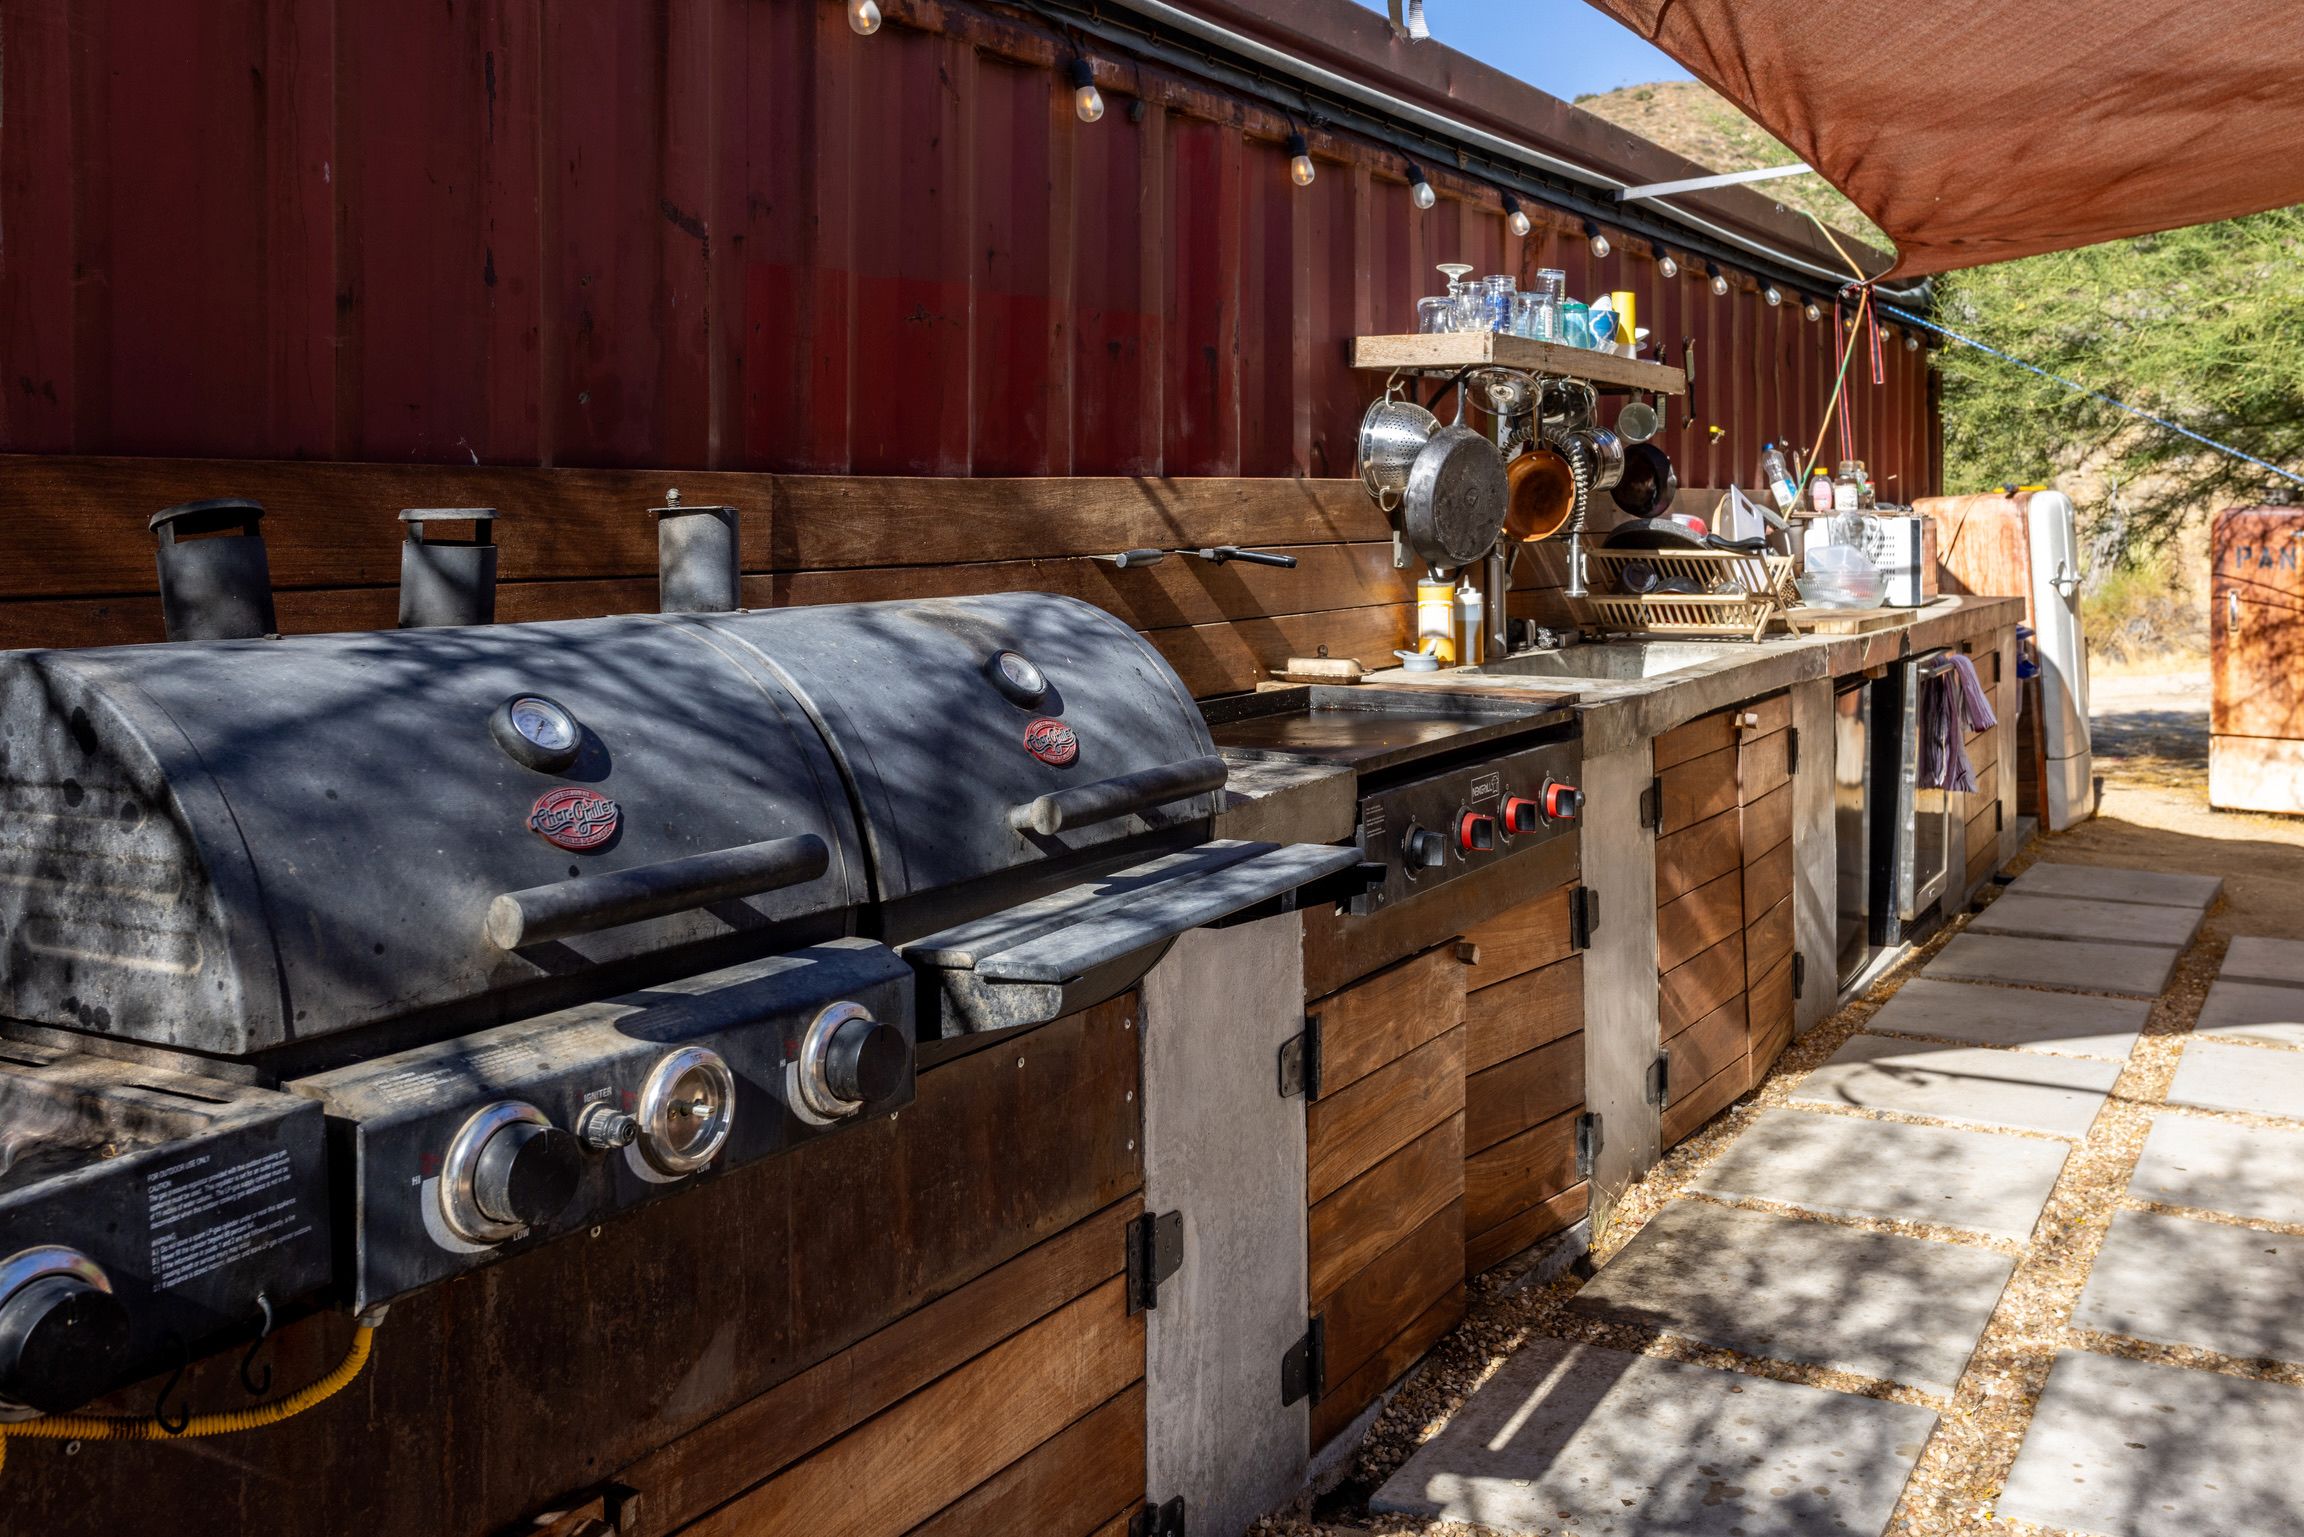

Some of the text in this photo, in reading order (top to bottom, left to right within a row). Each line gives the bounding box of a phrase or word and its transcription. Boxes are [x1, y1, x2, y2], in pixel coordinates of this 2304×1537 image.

[2236, 543, 2296, 571] PAN
[530, 798, 619, 838] Char-Griller
[583, 1086, 612, 1103] IGNITER
[411, 1174, 421, 1186] HI
[512, 1226, 530, 1241] LOW
